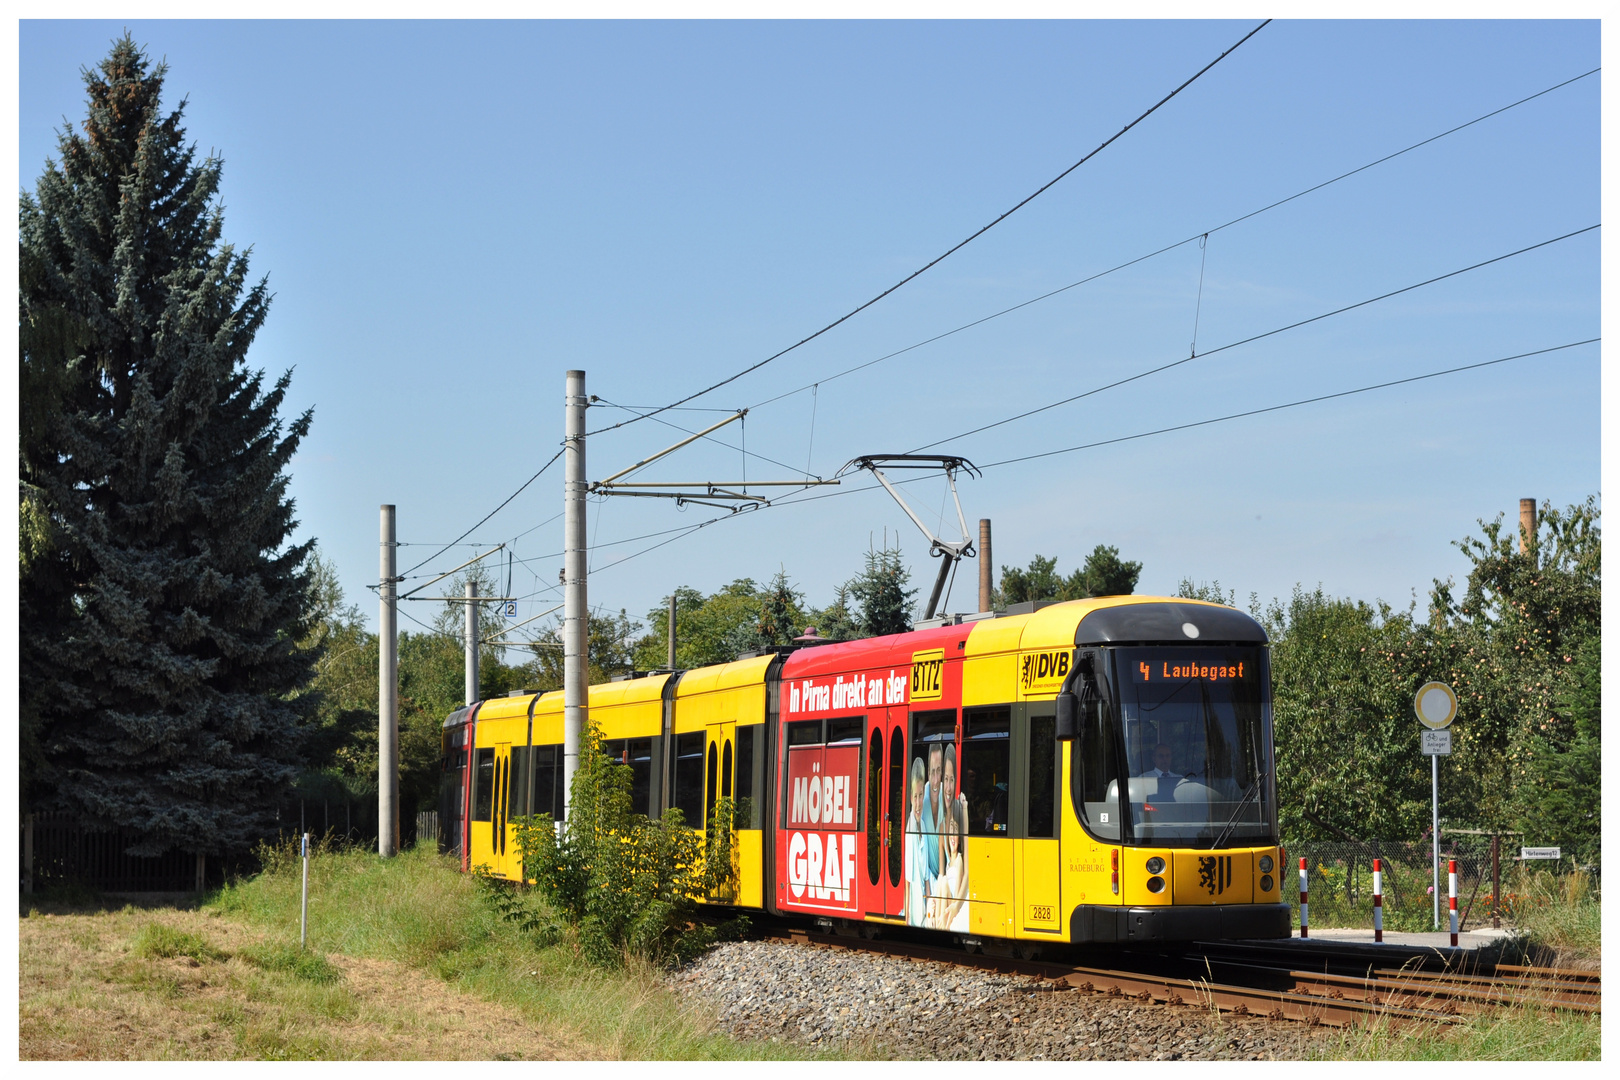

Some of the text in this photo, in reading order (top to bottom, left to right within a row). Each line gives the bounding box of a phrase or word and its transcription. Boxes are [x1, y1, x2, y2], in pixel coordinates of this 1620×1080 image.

[508, 604, 514, 614] 2
[1037, 652, 1069, 678] DVB
[1140, 661, 1244, 681] 4 Laubegast
[790, 659, 944, 712] In Pirna direkt an der B172
[792, 762, 853, 824] MÖBEL
[788, 832, 856, 902] GRAF
[1070, 864, 1104, 872] RADEBURG
[1034, 906, 1050, 920] 2828
